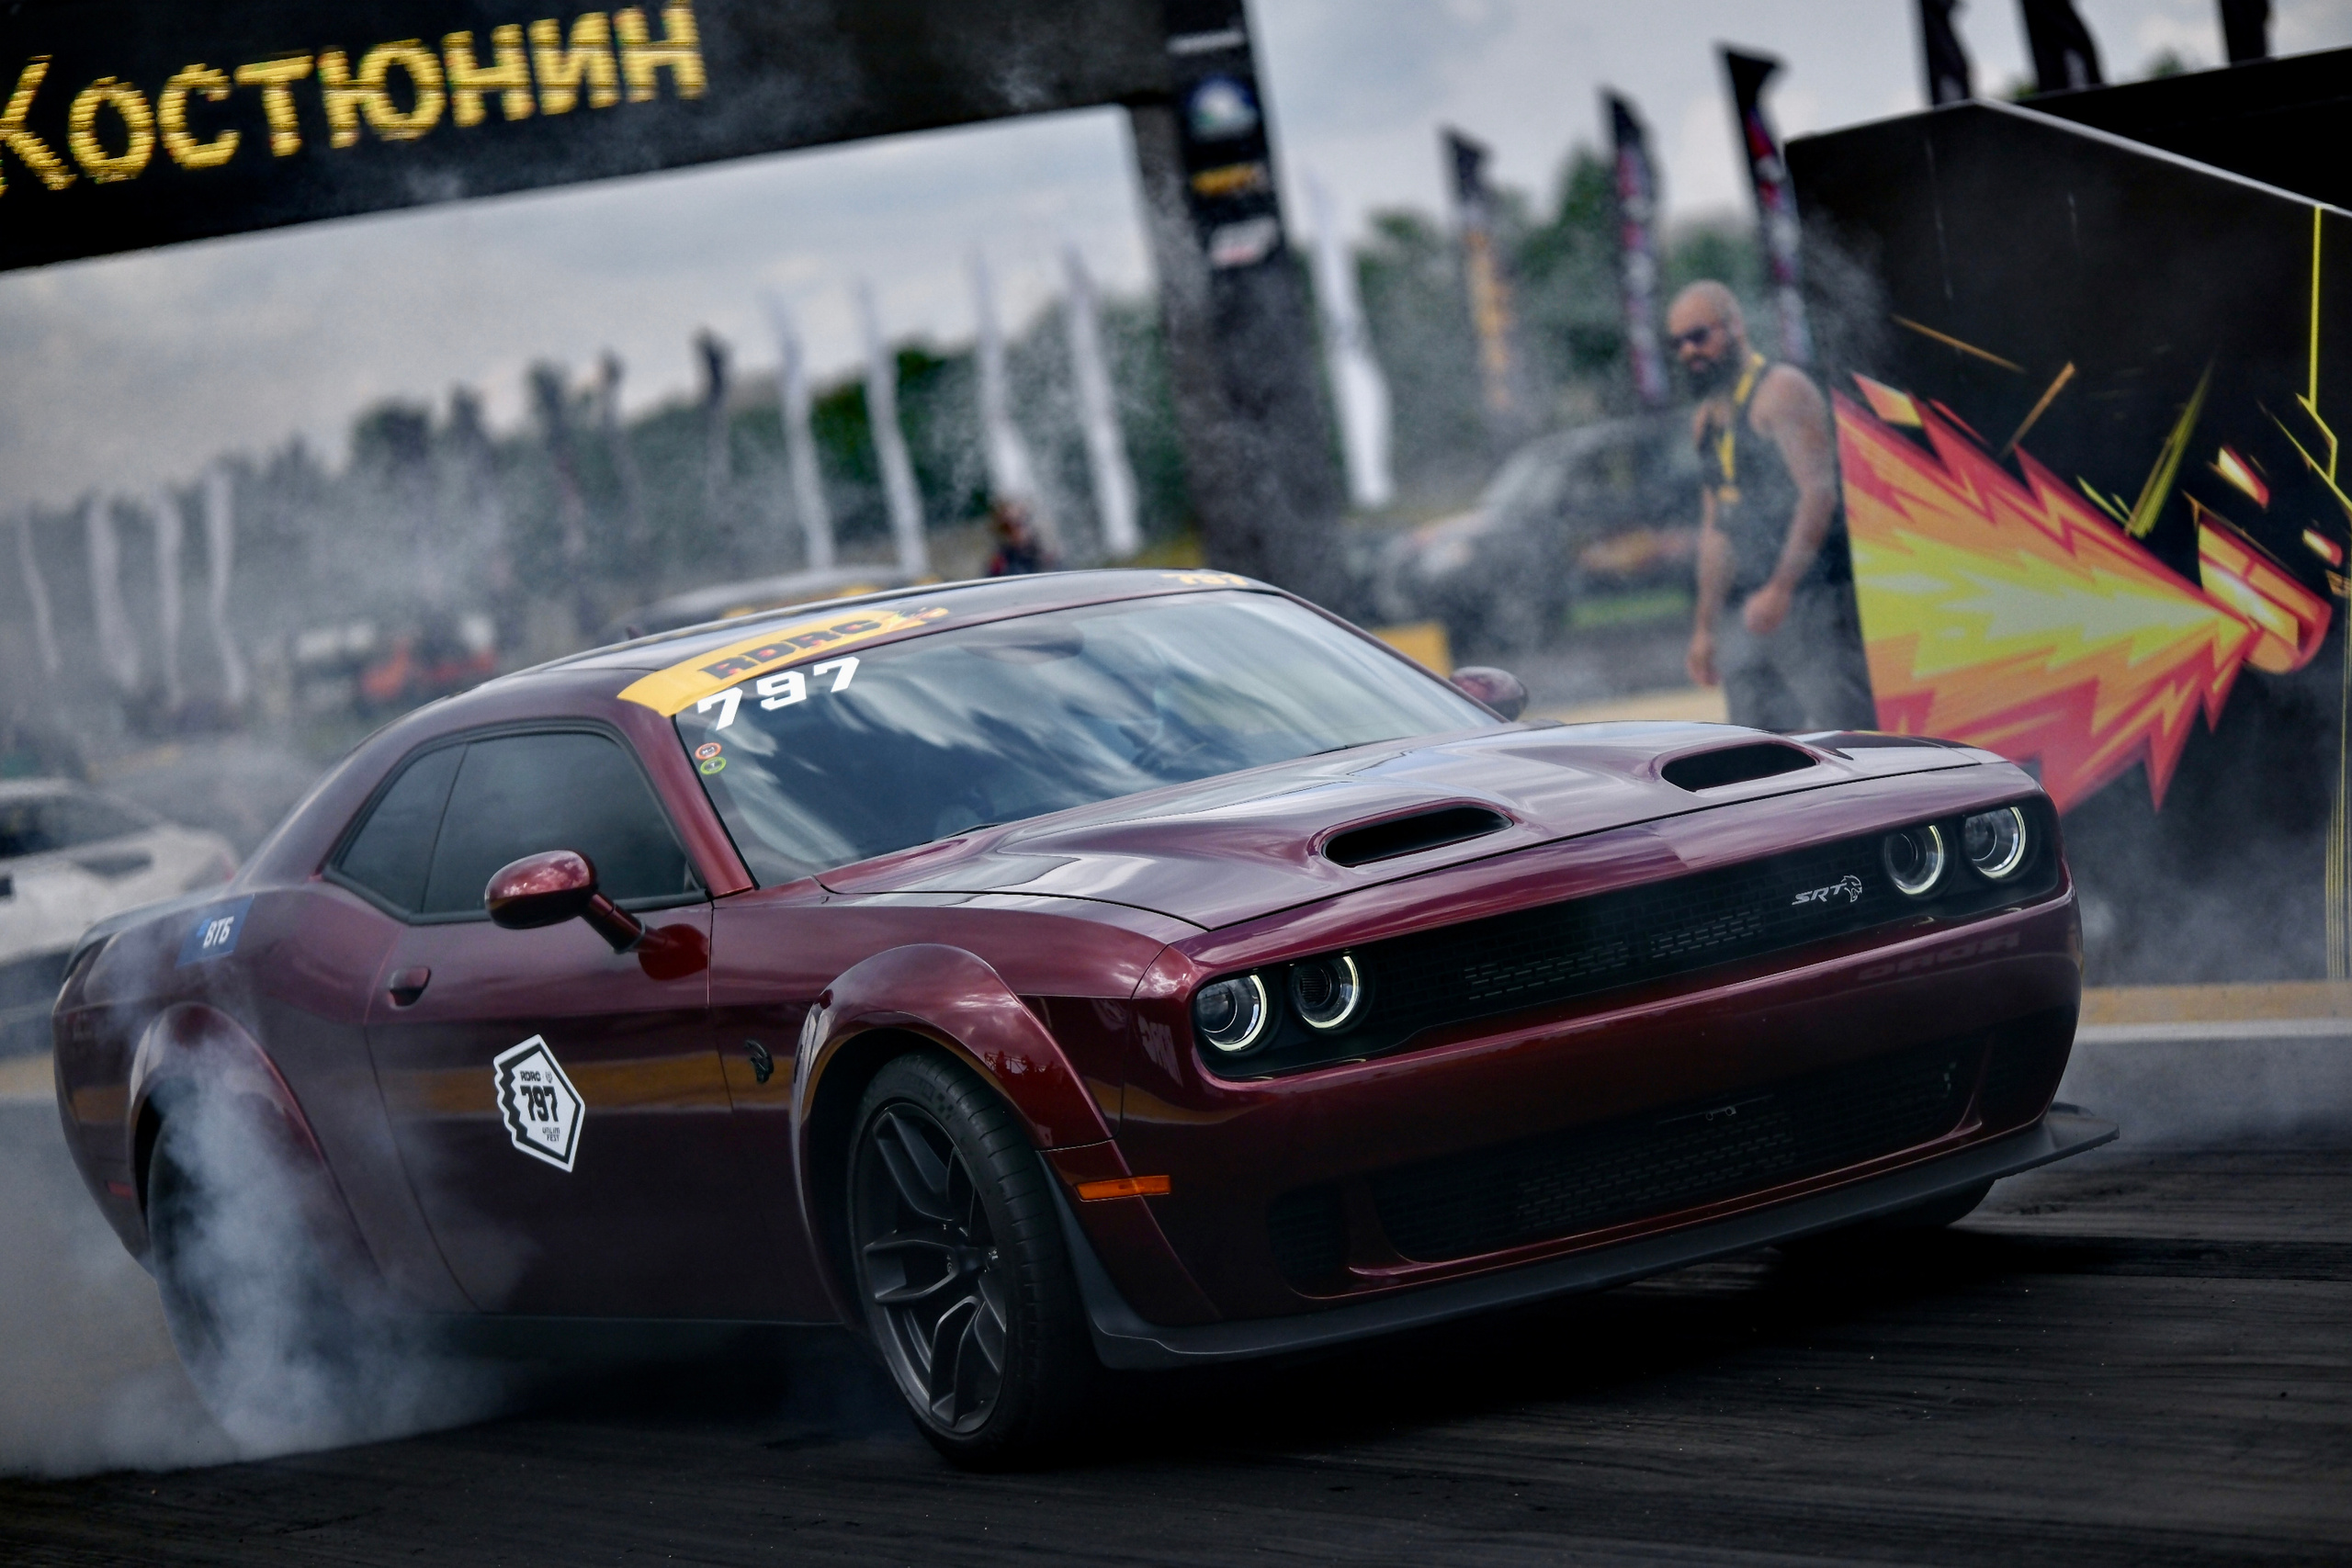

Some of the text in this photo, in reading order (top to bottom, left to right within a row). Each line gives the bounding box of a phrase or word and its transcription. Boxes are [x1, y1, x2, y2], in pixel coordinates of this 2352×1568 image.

[697, 620, 883, 680] RDRC
[697, 657, 860, 730] 797
[1792, 882, 1848, 906] SRT
[203, 916, 234, 949] ВТБ
[520, 1070, 541, 1082] RDRC
[520, 1086, 559, 1122] 797
